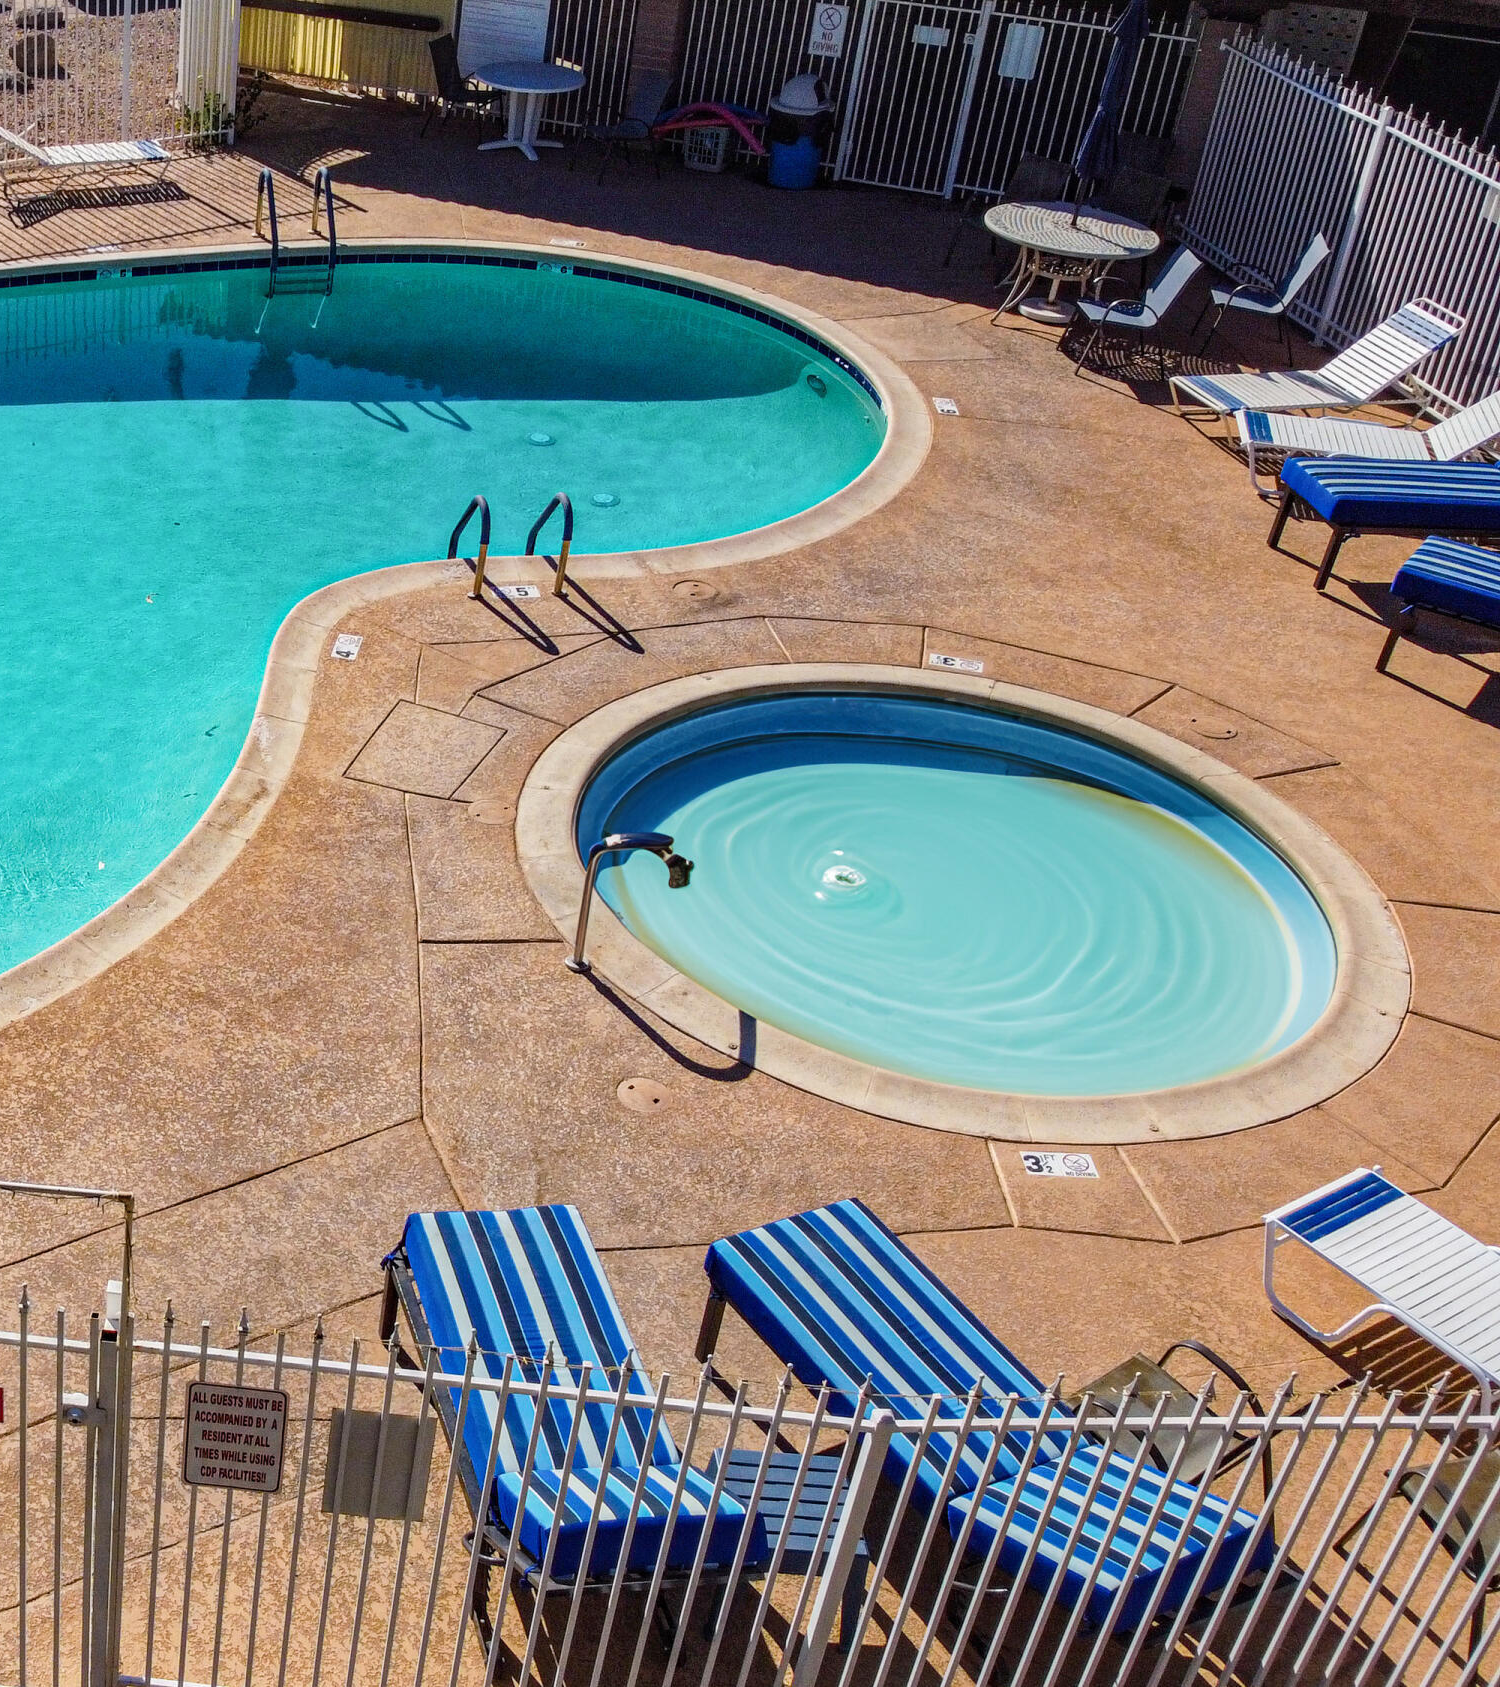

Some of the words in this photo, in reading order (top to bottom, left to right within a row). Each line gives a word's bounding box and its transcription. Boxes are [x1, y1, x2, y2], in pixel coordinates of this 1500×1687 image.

[822, 31, 833, 41] NO
[515, 587, 529, 597] 5
[1023, 1154, 1044, 1173] 3
[192, 1391, 208, 1404] ALL
[210, 1393, 243, 1407] GUESTS
[245, 1396, 269, 1410] MUST
[271, 1400, 283, 1412] BE
[194, 1410, 254, 1427] ACCOMPANIED
[255, 1417, 267, 1429] BY
[271, 1419, 277, 1430] A
[201, 1429, 243, 1445] RESIDENT
[243, 1434, 255, 1446] AT
[255, 1436, 270, 1448] ALL
[194, 1446, 219, 1460] TIMES
[221, 1449, 247, 1463] WHILE
[249, 1453, 275, 1467] USING
[200, 1465, 217, 1478] CDP
[219, 1467, 267, 1484] FACILITIES!!
